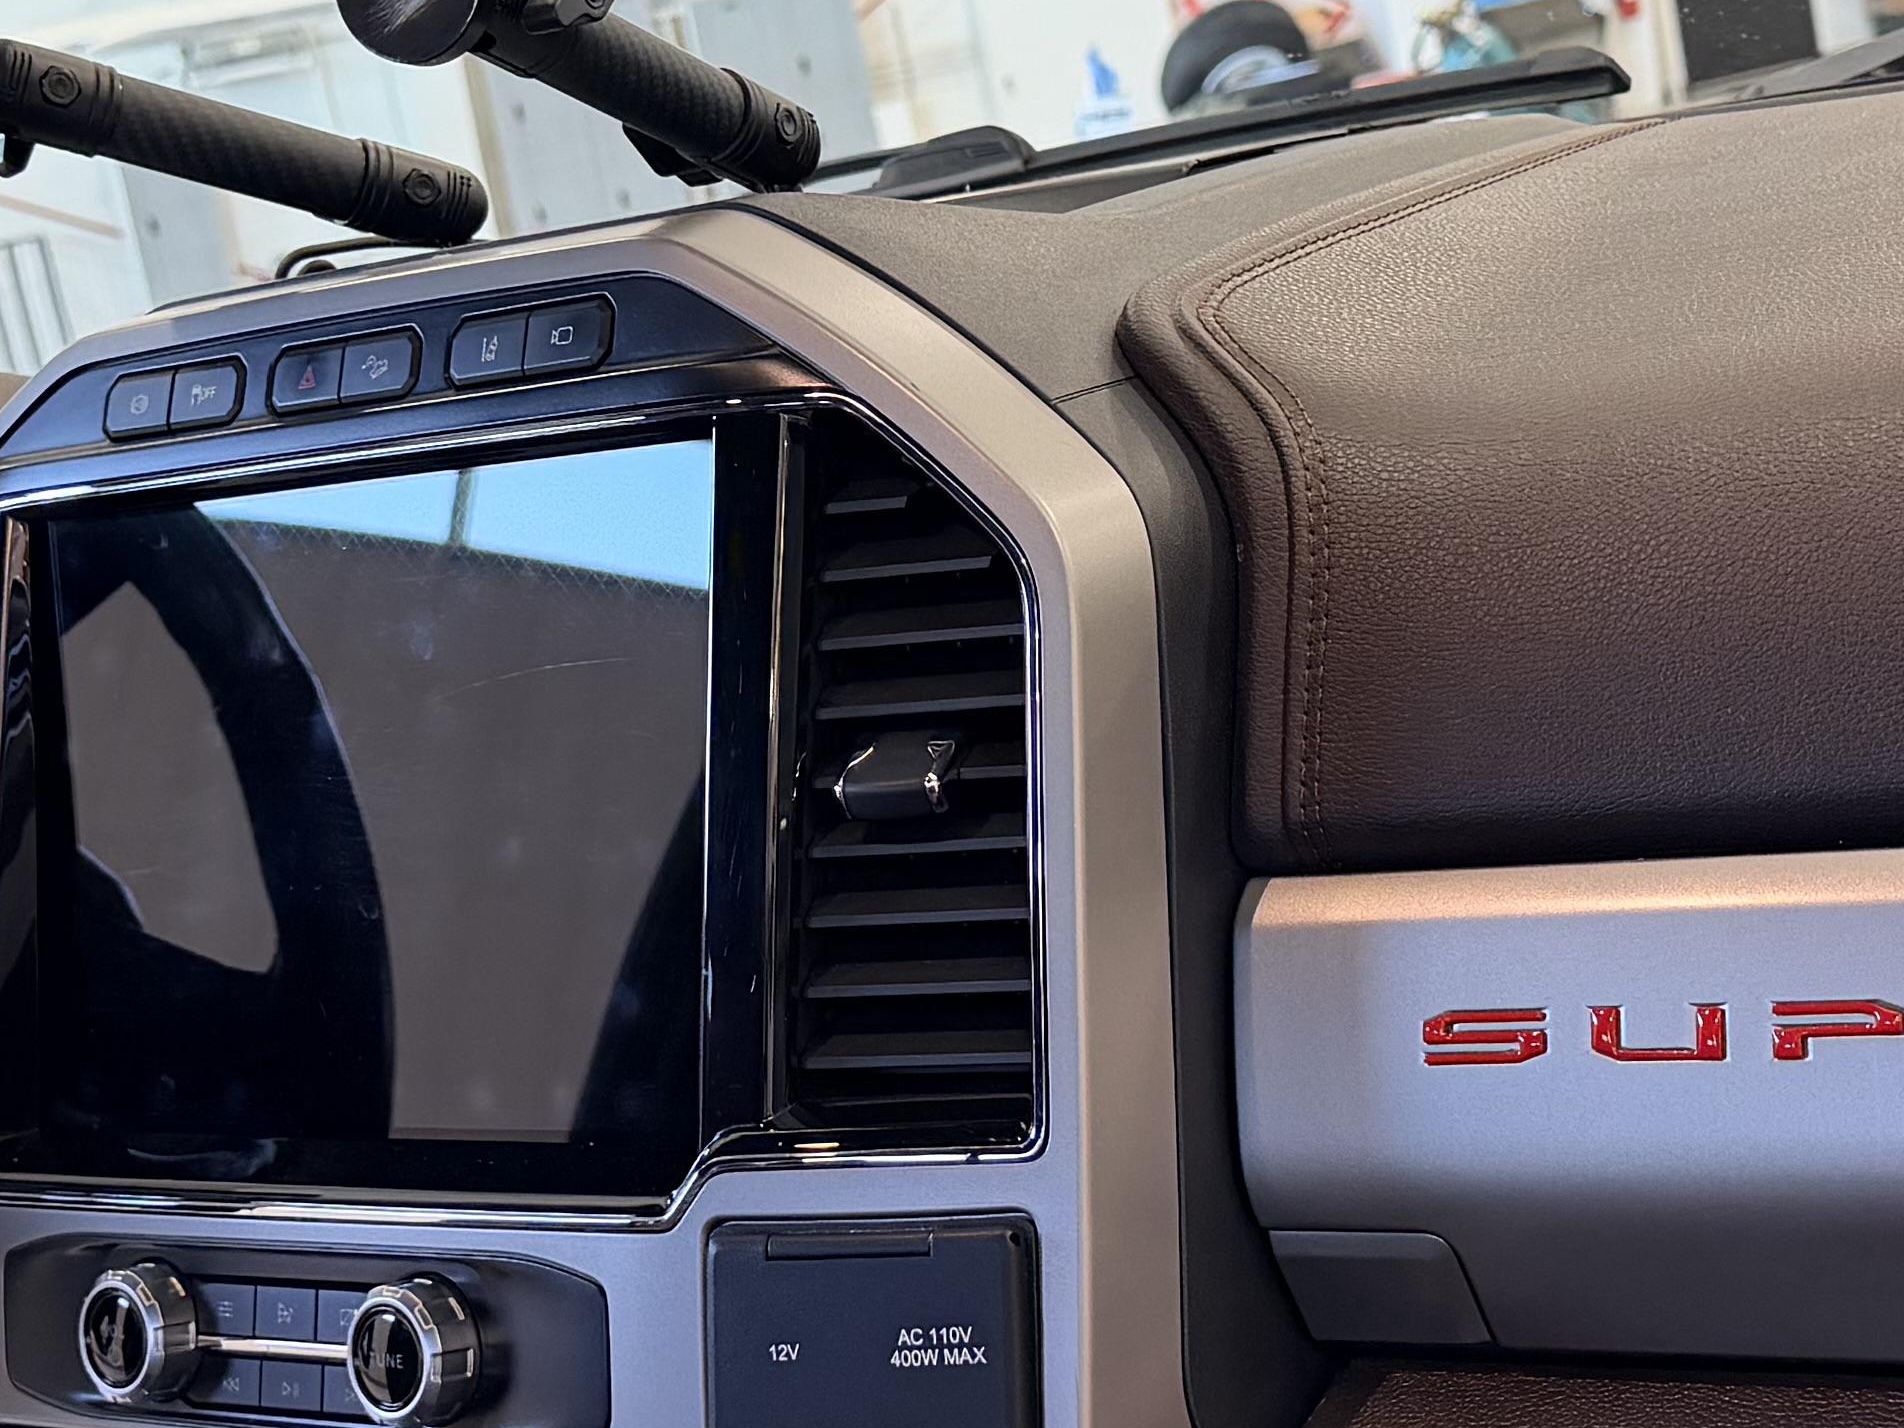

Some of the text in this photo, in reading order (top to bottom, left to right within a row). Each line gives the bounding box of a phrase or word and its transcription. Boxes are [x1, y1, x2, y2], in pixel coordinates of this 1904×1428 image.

[897, 1326, 972, 1347] AC 110V
[768, 1343, 800, 1361] 12V
[890, 1346, 987, 1368] 400W MAX
